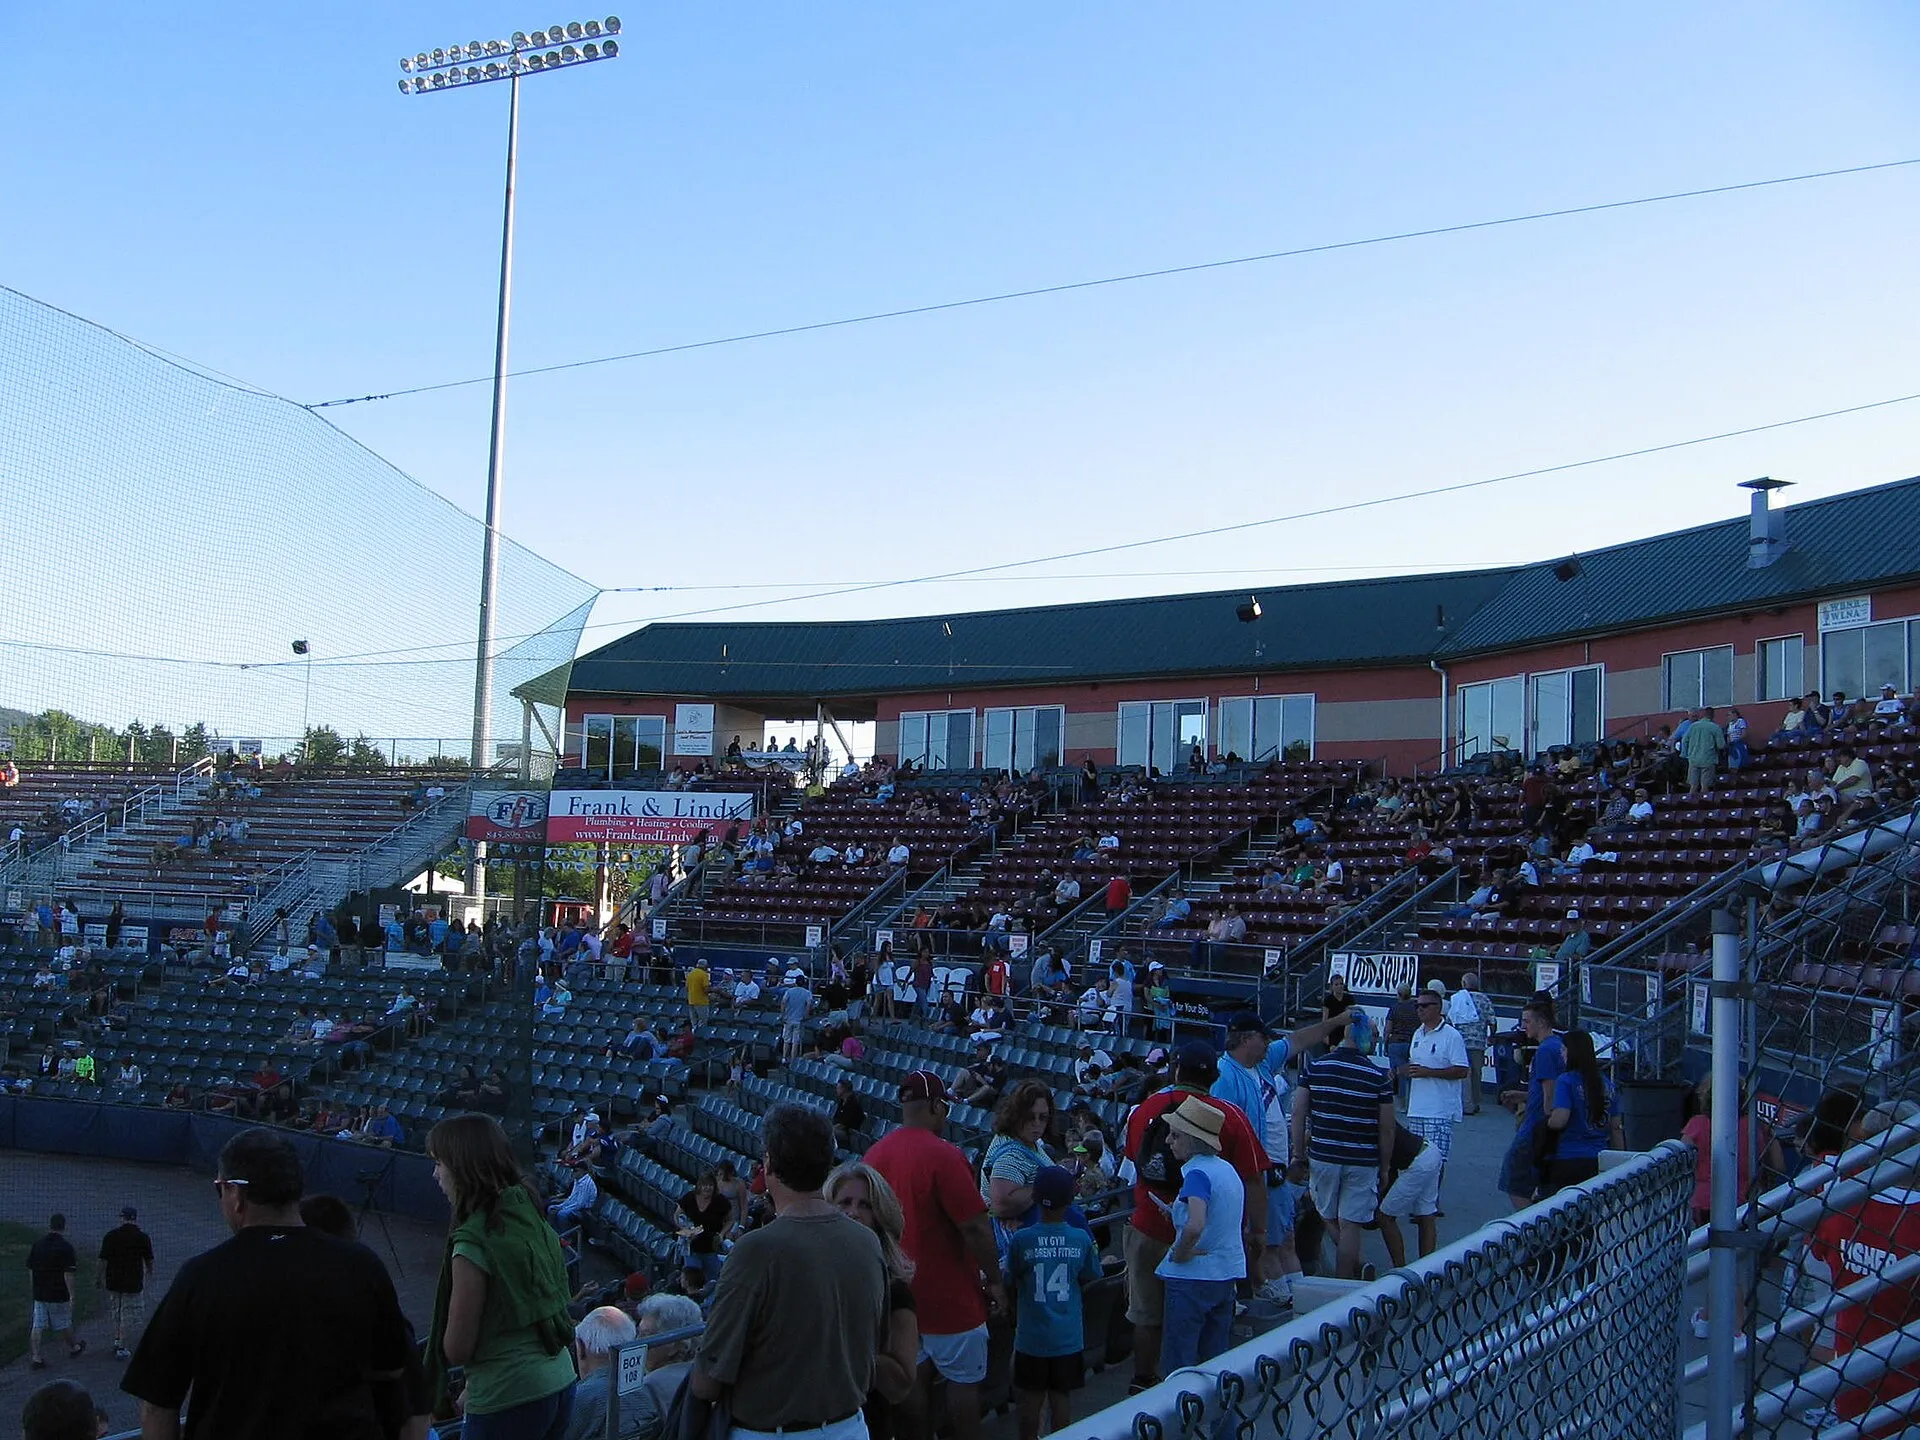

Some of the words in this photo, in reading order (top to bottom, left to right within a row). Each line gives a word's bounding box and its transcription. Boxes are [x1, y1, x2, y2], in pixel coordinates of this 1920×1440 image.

[568, 796, 633, 816] Frank
[641, 797, 664, 817] &
[674, 798, 741, 821] Lindy
[585, 817, 627, 828] Plumbing
[636, 818, 670, 829] Heating
[1033, 1262, 1070, 1302] 14
[623, 1355, 642, 1370] BOX
